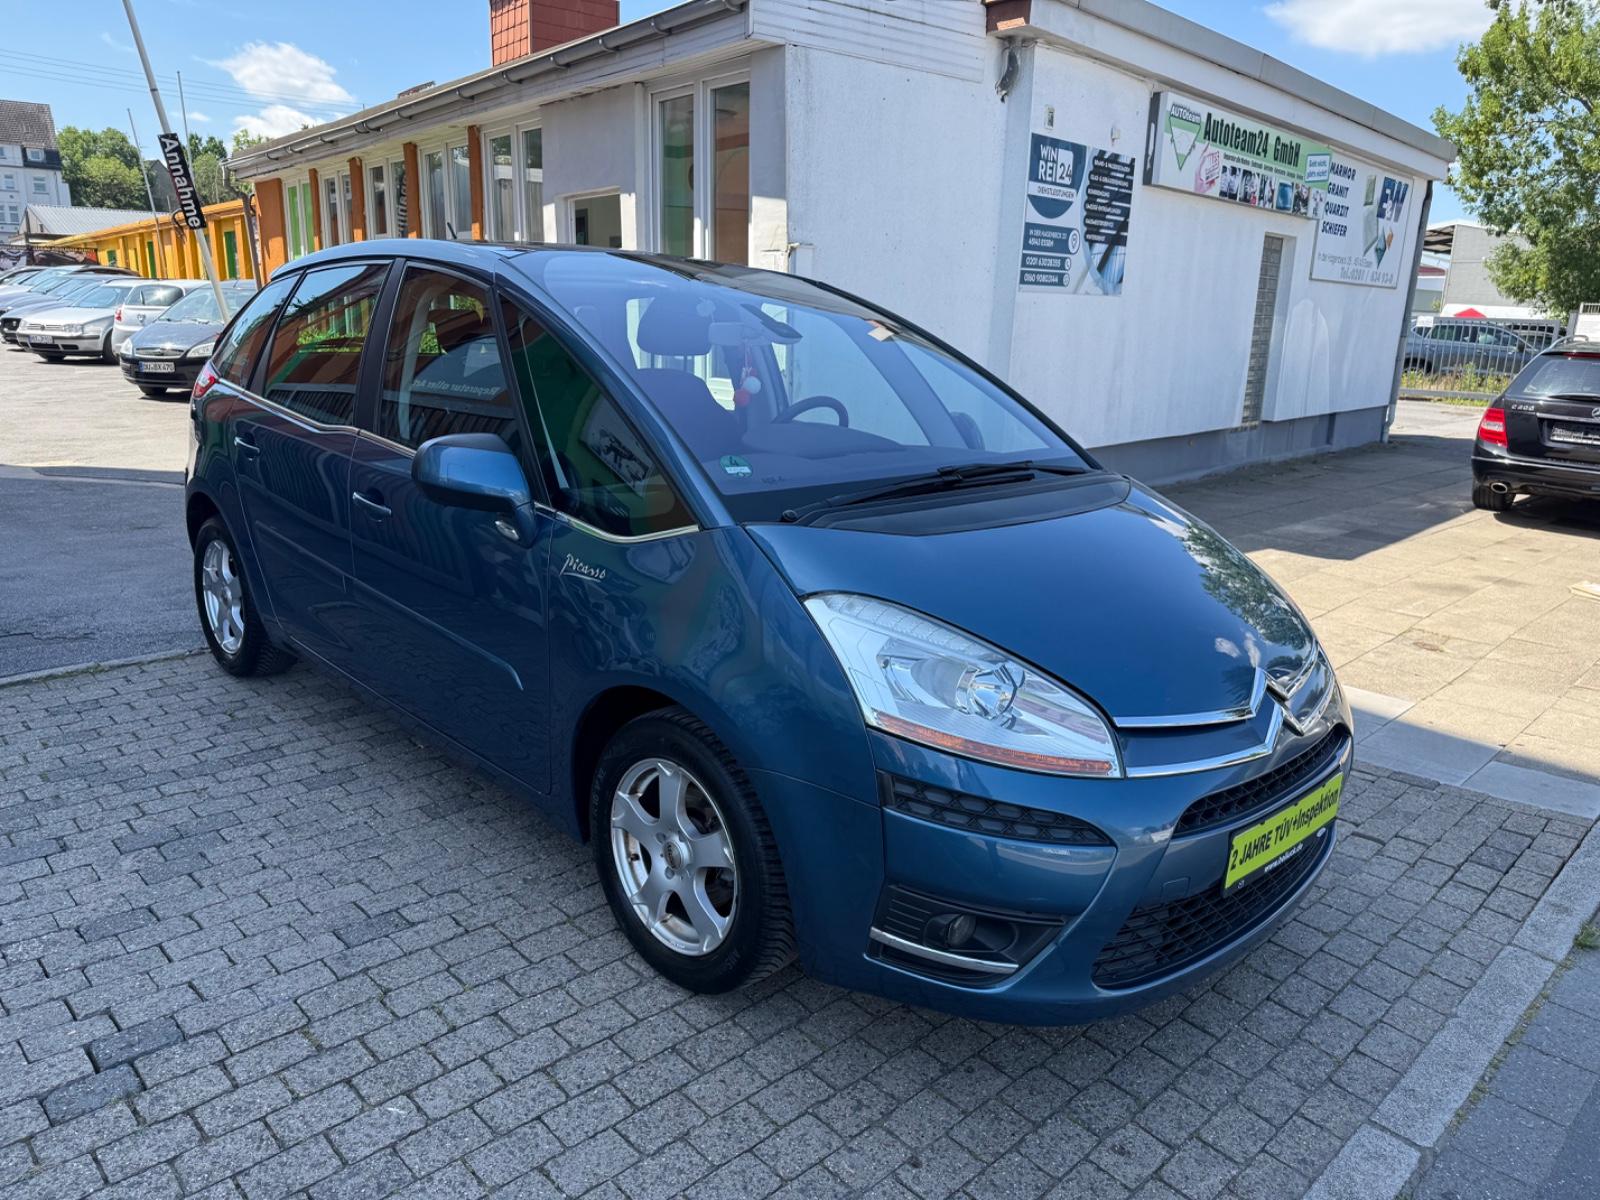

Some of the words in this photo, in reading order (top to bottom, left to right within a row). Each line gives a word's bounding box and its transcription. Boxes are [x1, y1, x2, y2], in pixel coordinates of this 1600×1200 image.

[1203, 112, 1269, 158] Autoteam24
[1274, 136, 1301, 167] GmbH
[1040, 144, 1057, 161] WIN
[1038, 160, 1056, 182] REI
[1059, 162, 1072, 181] 24
[1329, 162, 1356, 180] MARMOR
[161, 137, 201, 229] Annahme
[1328, 182, 1349, 198] GRANIT
[1324, 201, 1349, 218] QUARZIT
[1321, 220, 1347, 237] SCHIEFER
[559, 553, 606, 582] Picasso
[1230, 849, 1239, 871] 2
[1239, 830, 1273, 865] JAHRE
